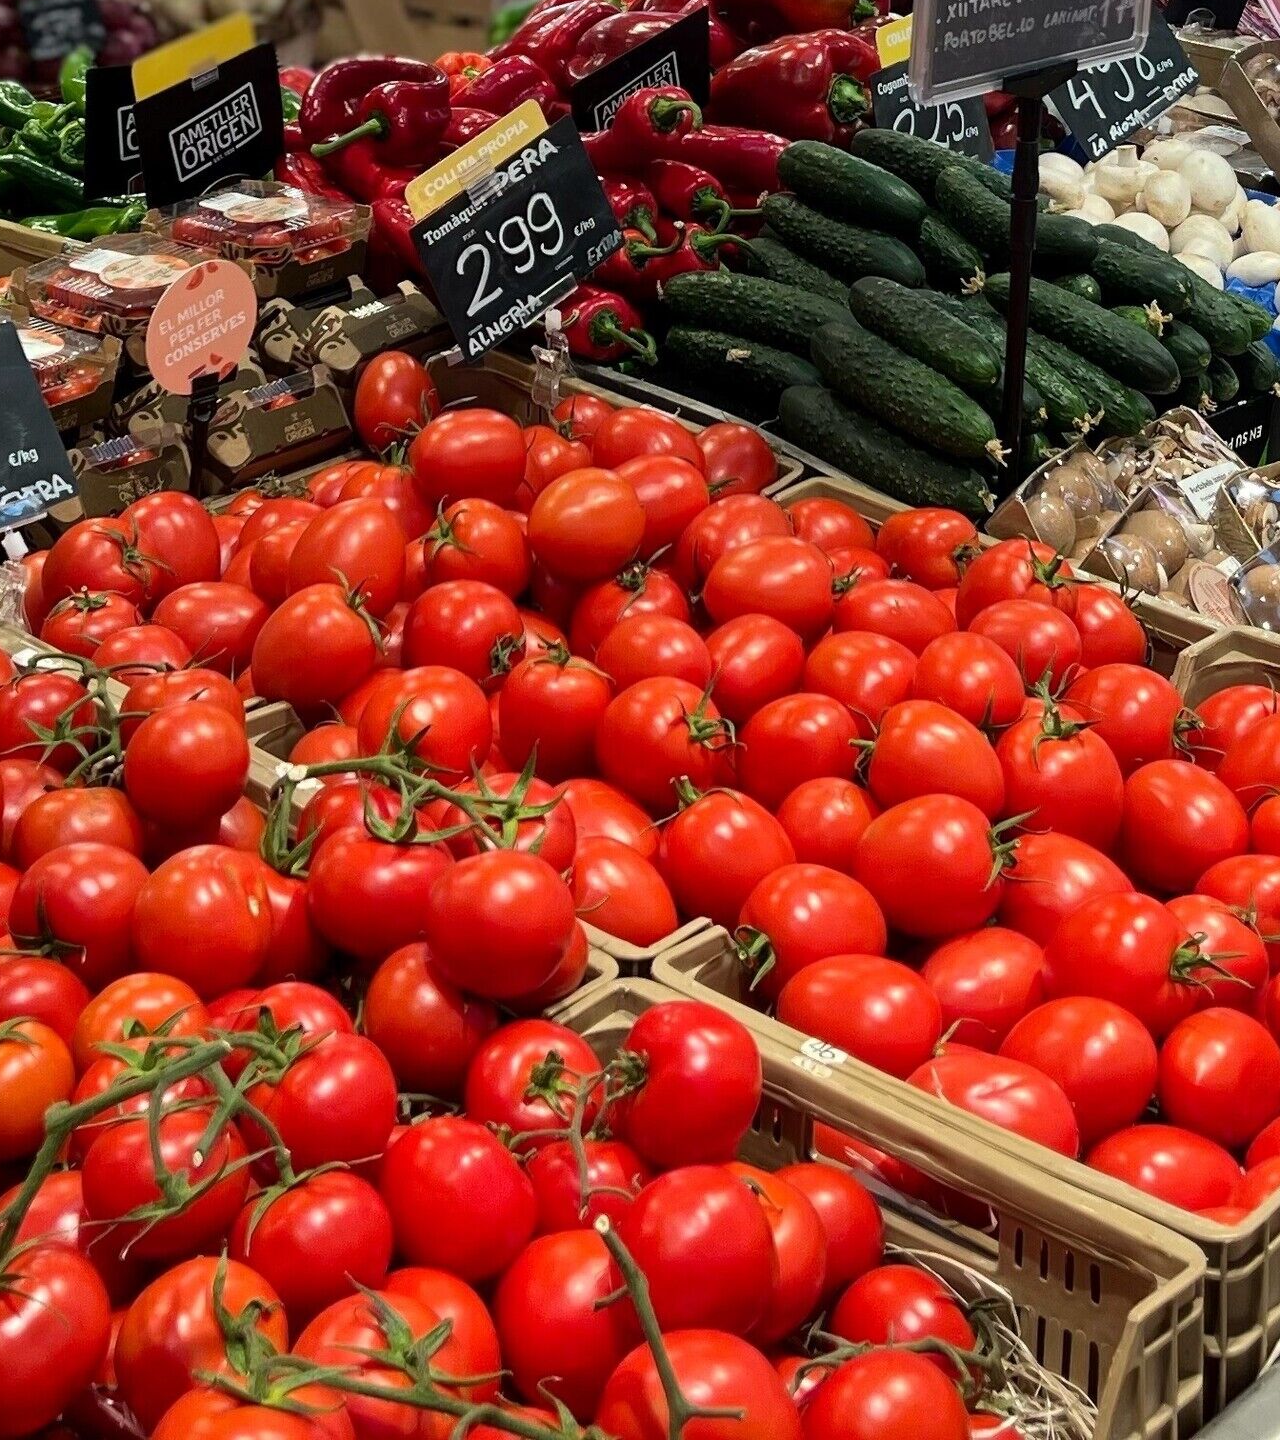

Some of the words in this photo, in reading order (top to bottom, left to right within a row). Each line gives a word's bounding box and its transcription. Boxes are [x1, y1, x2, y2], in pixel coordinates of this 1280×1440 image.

[179, 92, 252, 152] AMETLLER
[181, 108, 257, 170] ORIGEN
[456, 191, 565, 318] 2'99
[158, 319, 176, 337] EL
[176, 288, 226, 324] MILLOR
[164, 310, 247, 368] CONSERVES
[168, 323, 196, 348] PER
[197, 308, 223, 332] FER
[8, 447, 39, 468] €/kg
